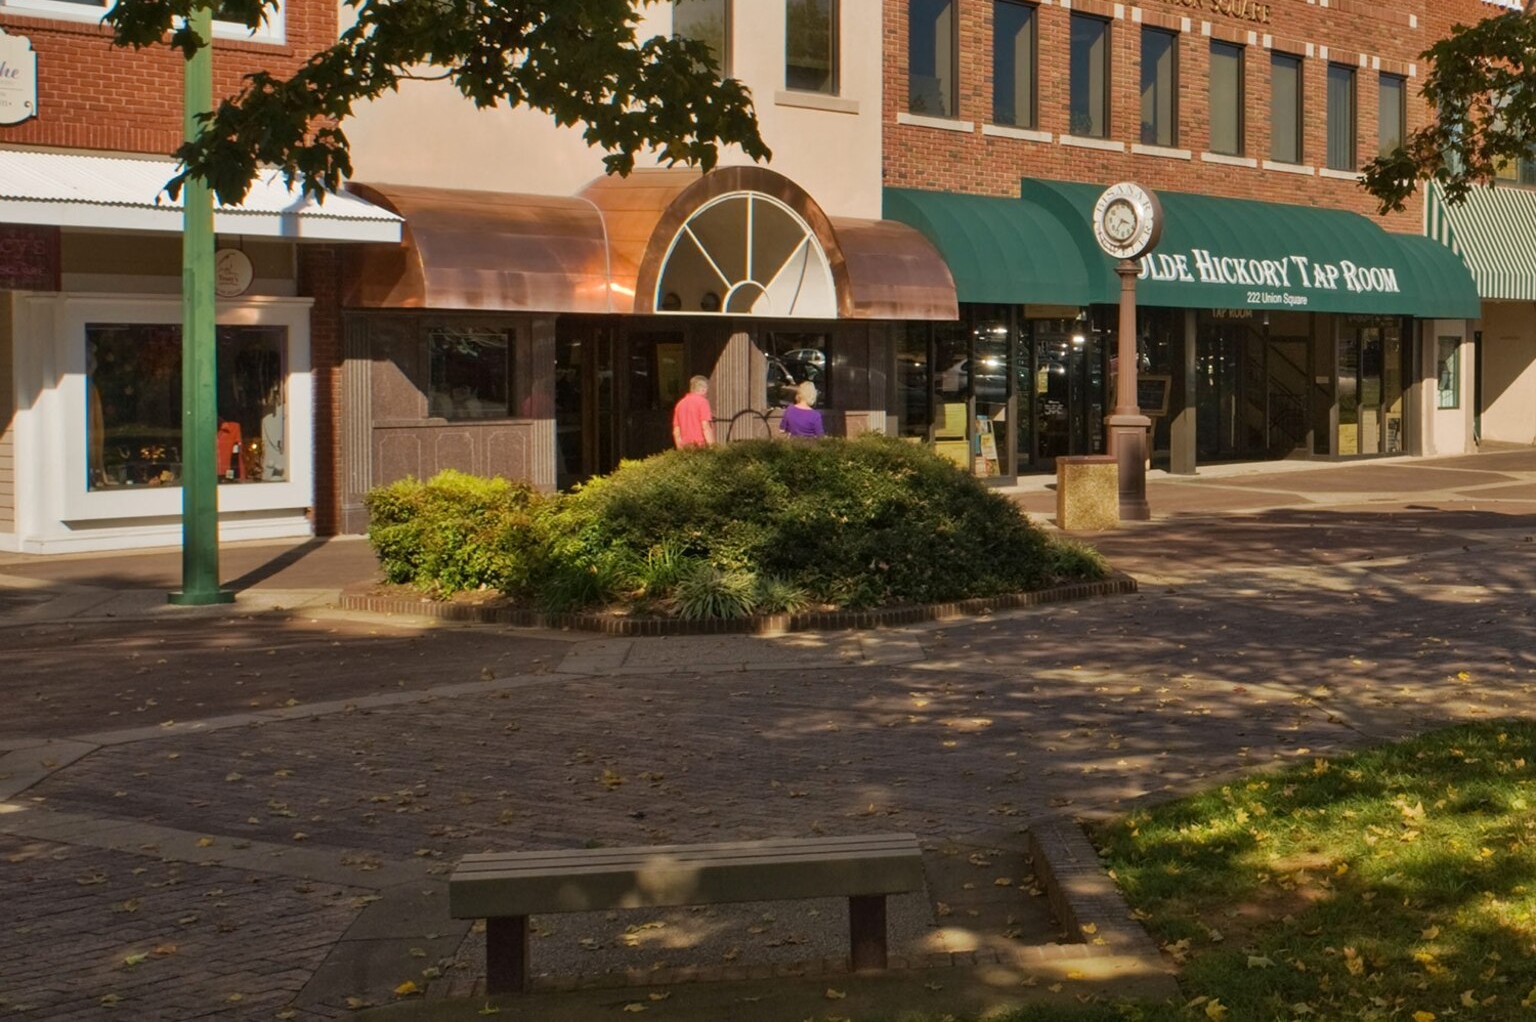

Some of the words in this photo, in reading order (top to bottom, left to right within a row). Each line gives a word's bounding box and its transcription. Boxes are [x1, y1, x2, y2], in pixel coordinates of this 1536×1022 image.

[1191, 248, 1292, 287] HICKORY
[1288, 255, 1339, 290] TAP
[1339, 259, 1401, 294] ROOM
[1246, 291, 1261, 304] 222
[1262, 292, 1282, 305] Union
[1283, 294, 1308, 307] Square
